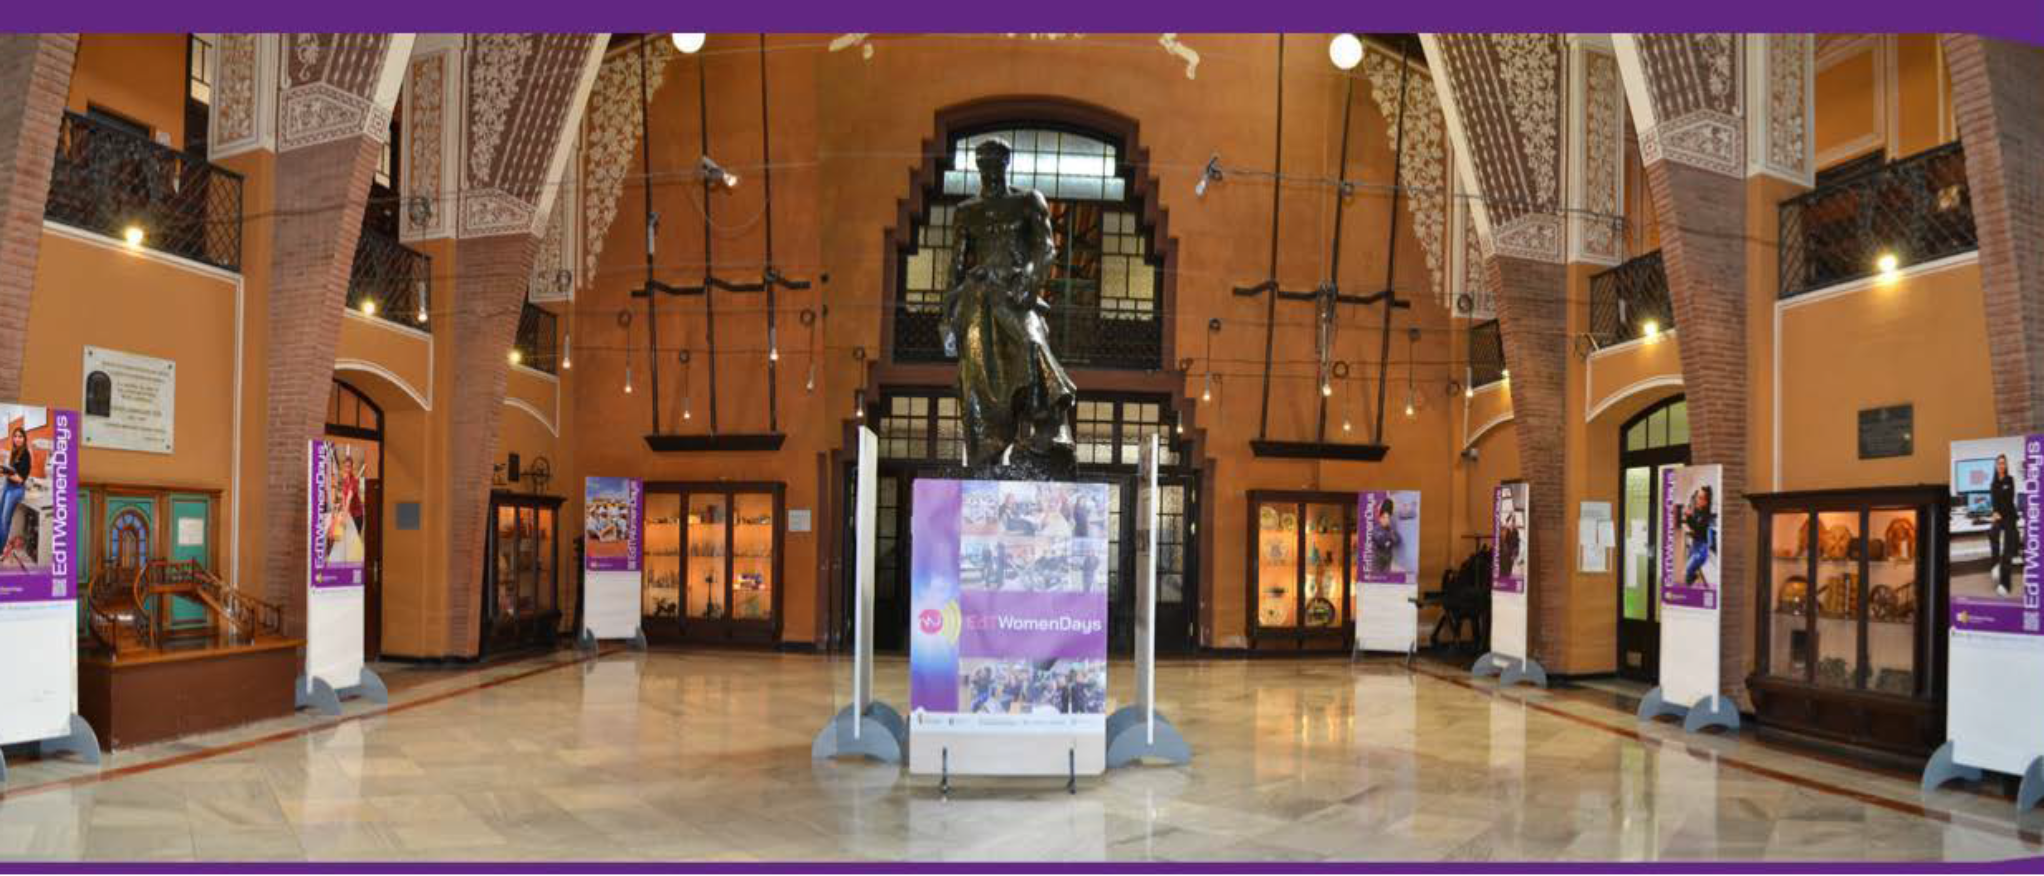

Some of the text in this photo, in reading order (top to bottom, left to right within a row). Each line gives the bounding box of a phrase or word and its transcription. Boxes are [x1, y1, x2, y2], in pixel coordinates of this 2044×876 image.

[52, 415, 70, 576] EdTWomenDays
[315, 444, 326, 569] EdTWomenDays
[2023, 441, 2043, 609] EdTWomenDays
[967, 614, 1102, 634] EdTWomenDays
